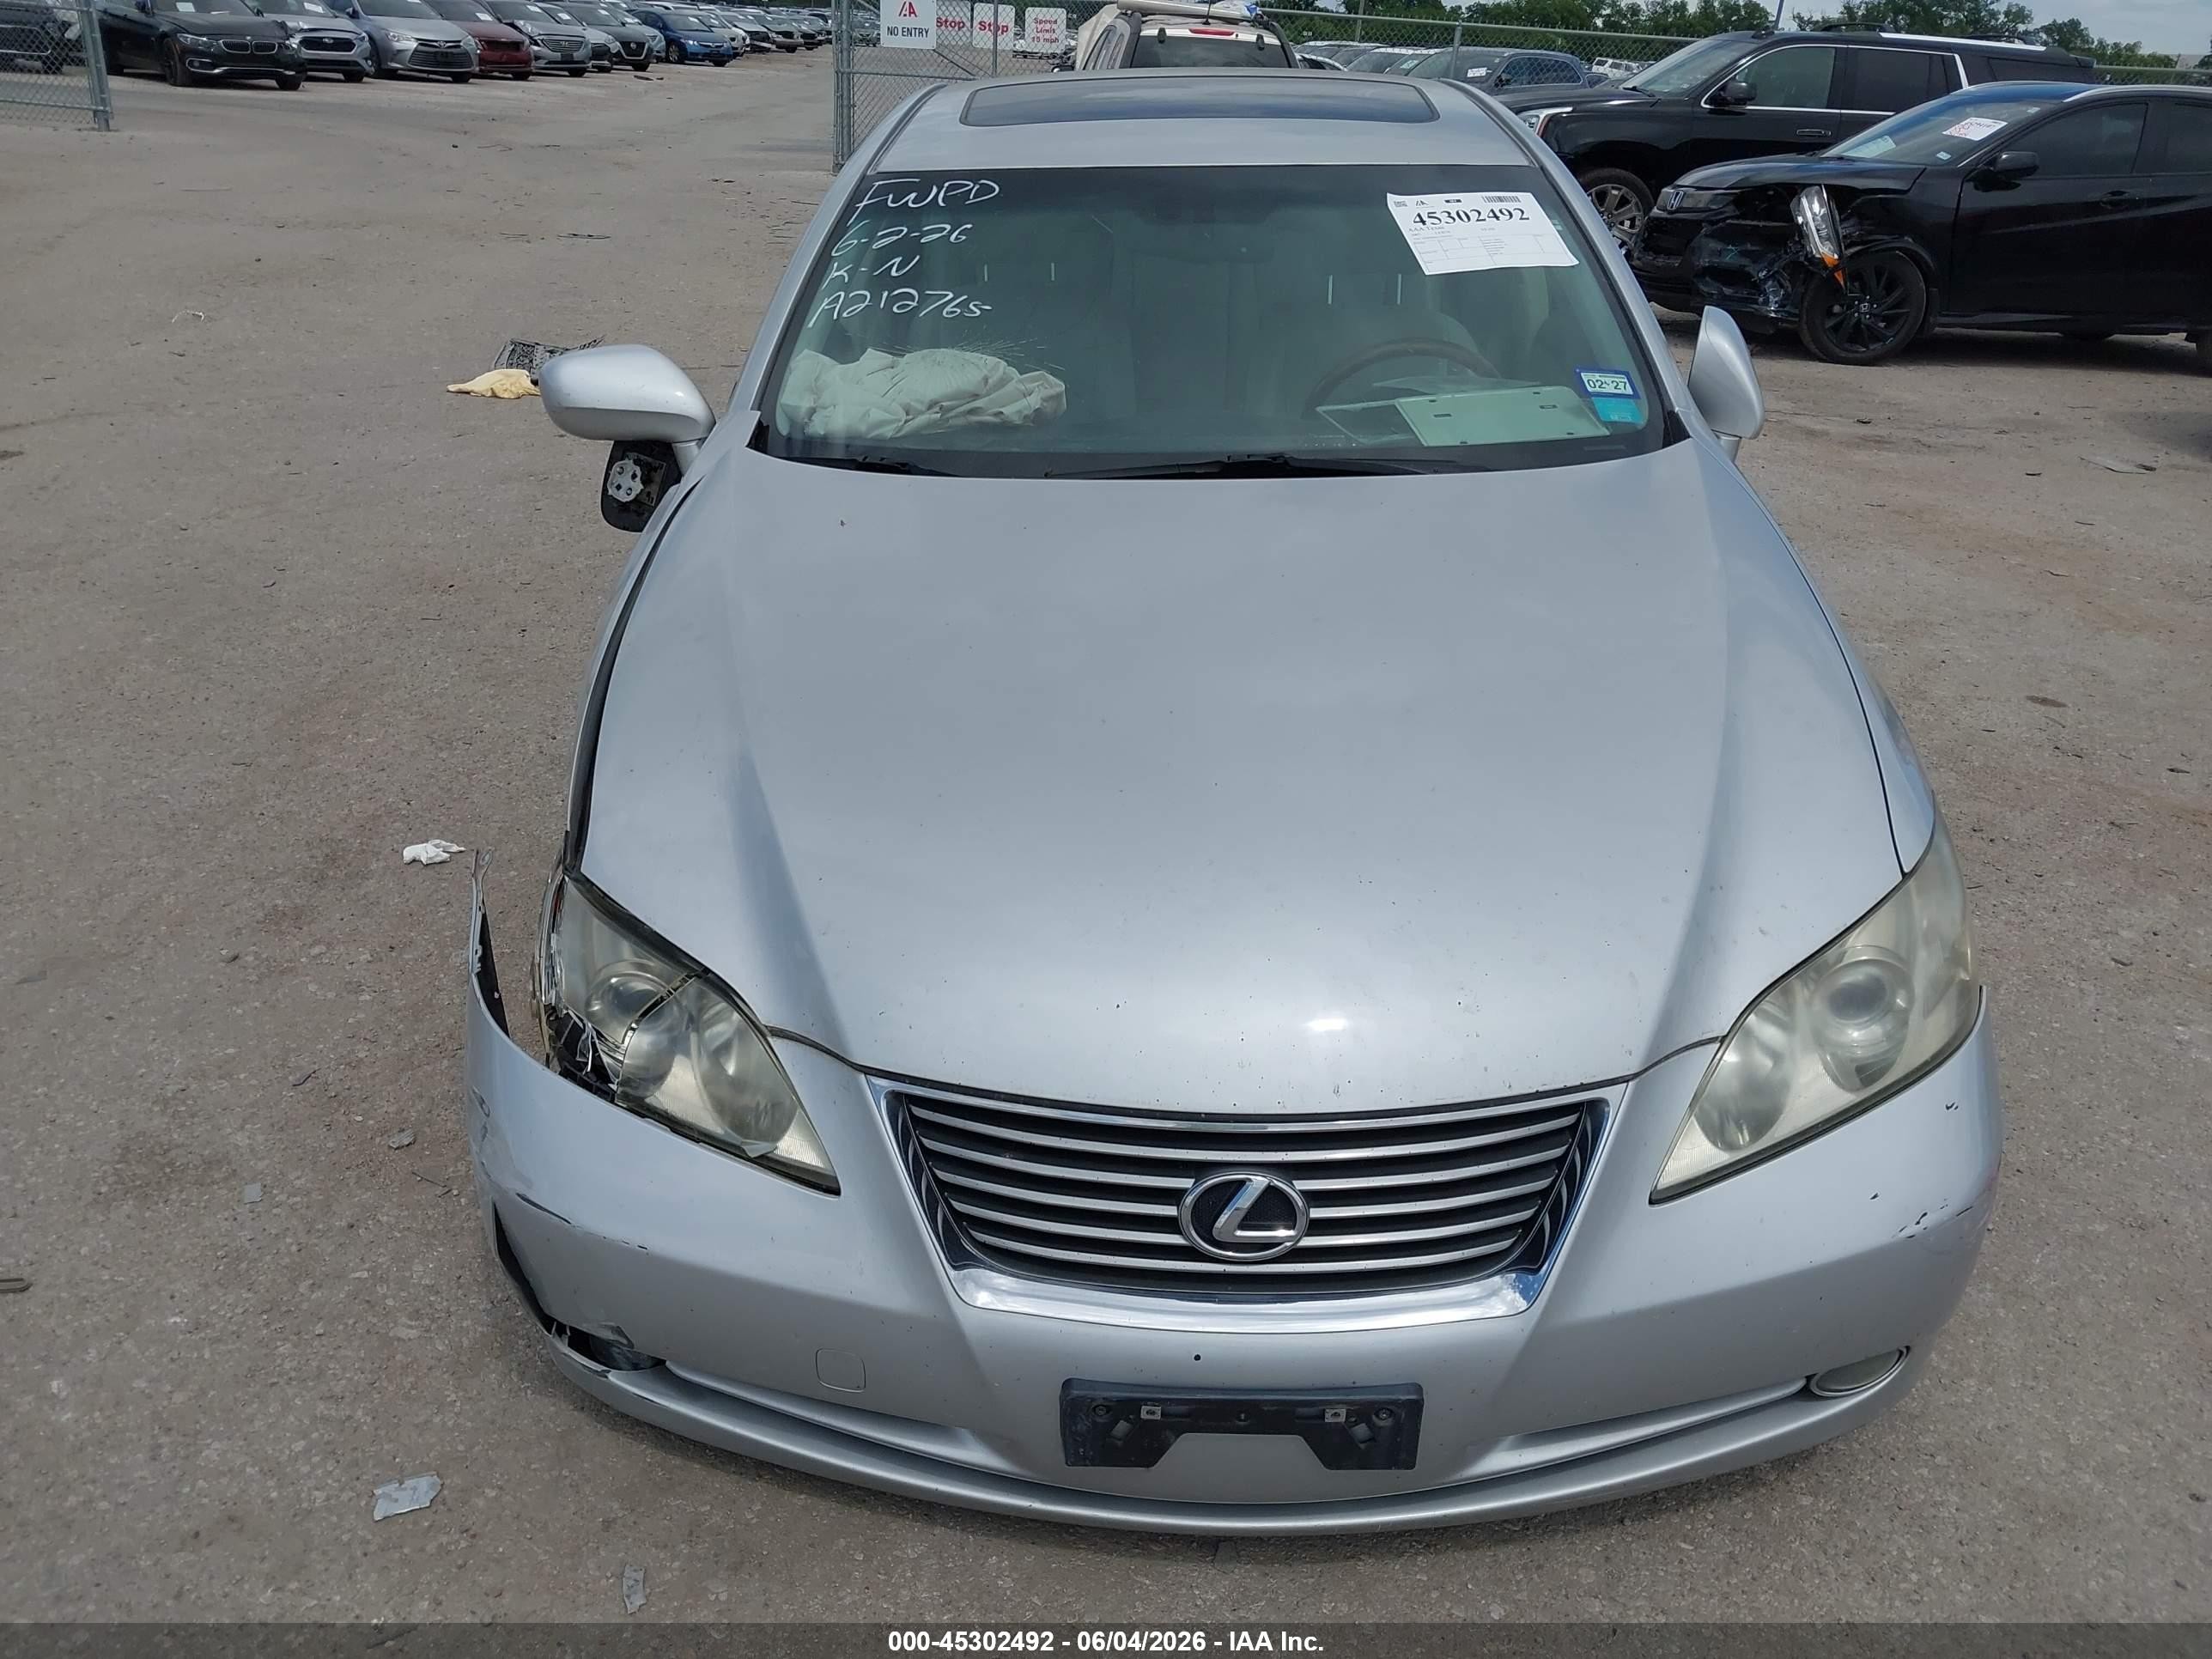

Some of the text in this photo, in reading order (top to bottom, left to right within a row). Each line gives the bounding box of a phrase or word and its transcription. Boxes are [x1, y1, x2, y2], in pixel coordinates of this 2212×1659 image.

[887, 26, 930, 38] NO ENTRY
[936, 17, 965, 31] Stop
[847, 178, 1000, 227] FWPD
[1413, 207, 1530, 226] 45302492
[830, 220, 973, 256] 6-2-26
[1587, 379, 1627, 391] 02 27
